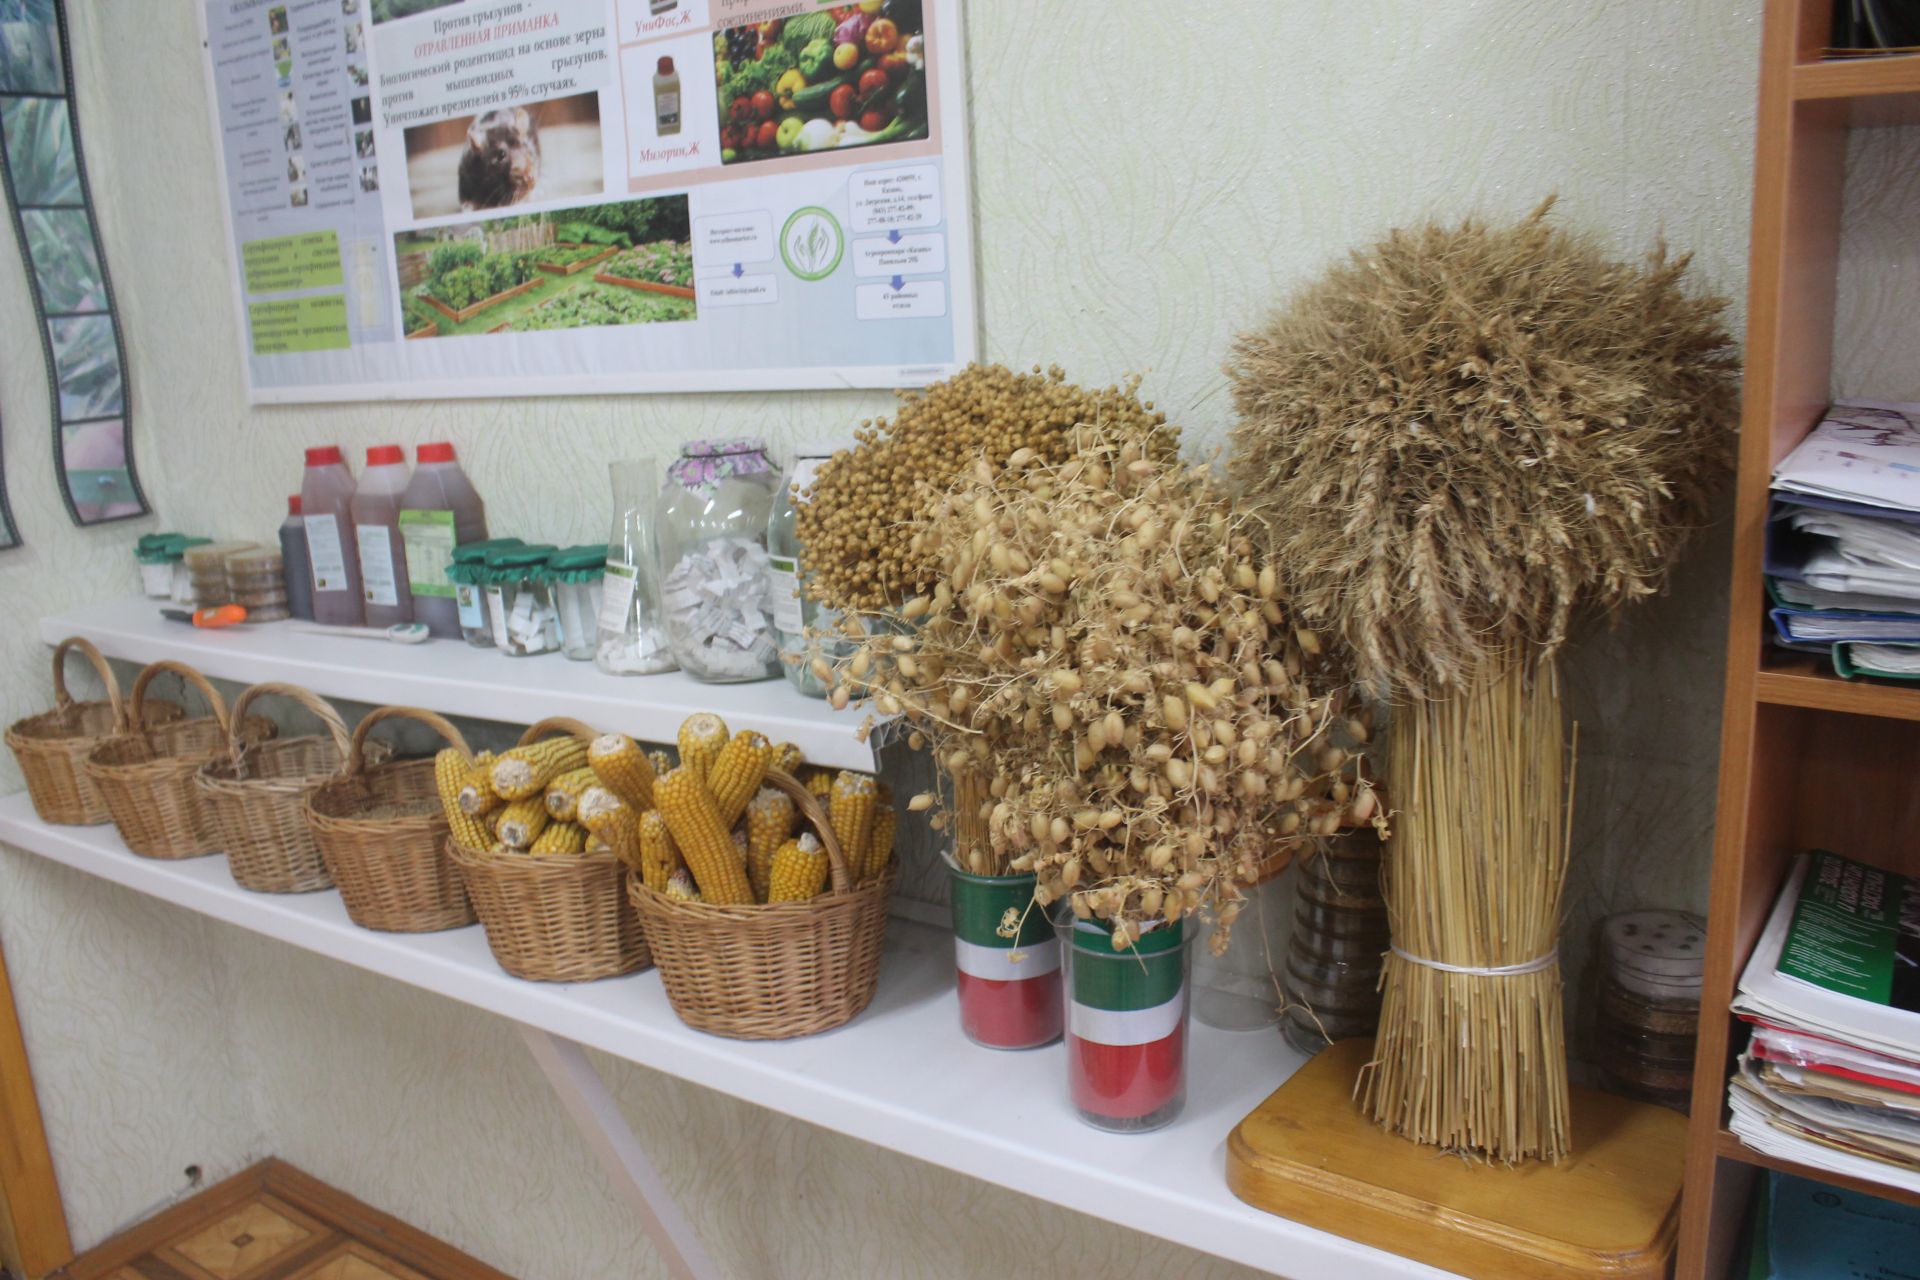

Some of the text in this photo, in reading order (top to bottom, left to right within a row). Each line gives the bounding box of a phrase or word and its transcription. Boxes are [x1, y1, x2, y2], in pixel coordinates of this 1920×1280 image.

[413, 12, 560, 58] ОТРАВЛЕННАЯ ПРИМАНКА
[433, 15, 470, 35] Против
[473, 3, 523, 27] грызунов
[380, 27, 605, 87] Биологический родентицид на основе зерна
[382, 49, 607, 108] против мышевидных грызунов.
[383, 104, 439, 128] Уничтожает
[441, 91, 499, 116] вредителей
[508, 84, 529, 99] 95%
